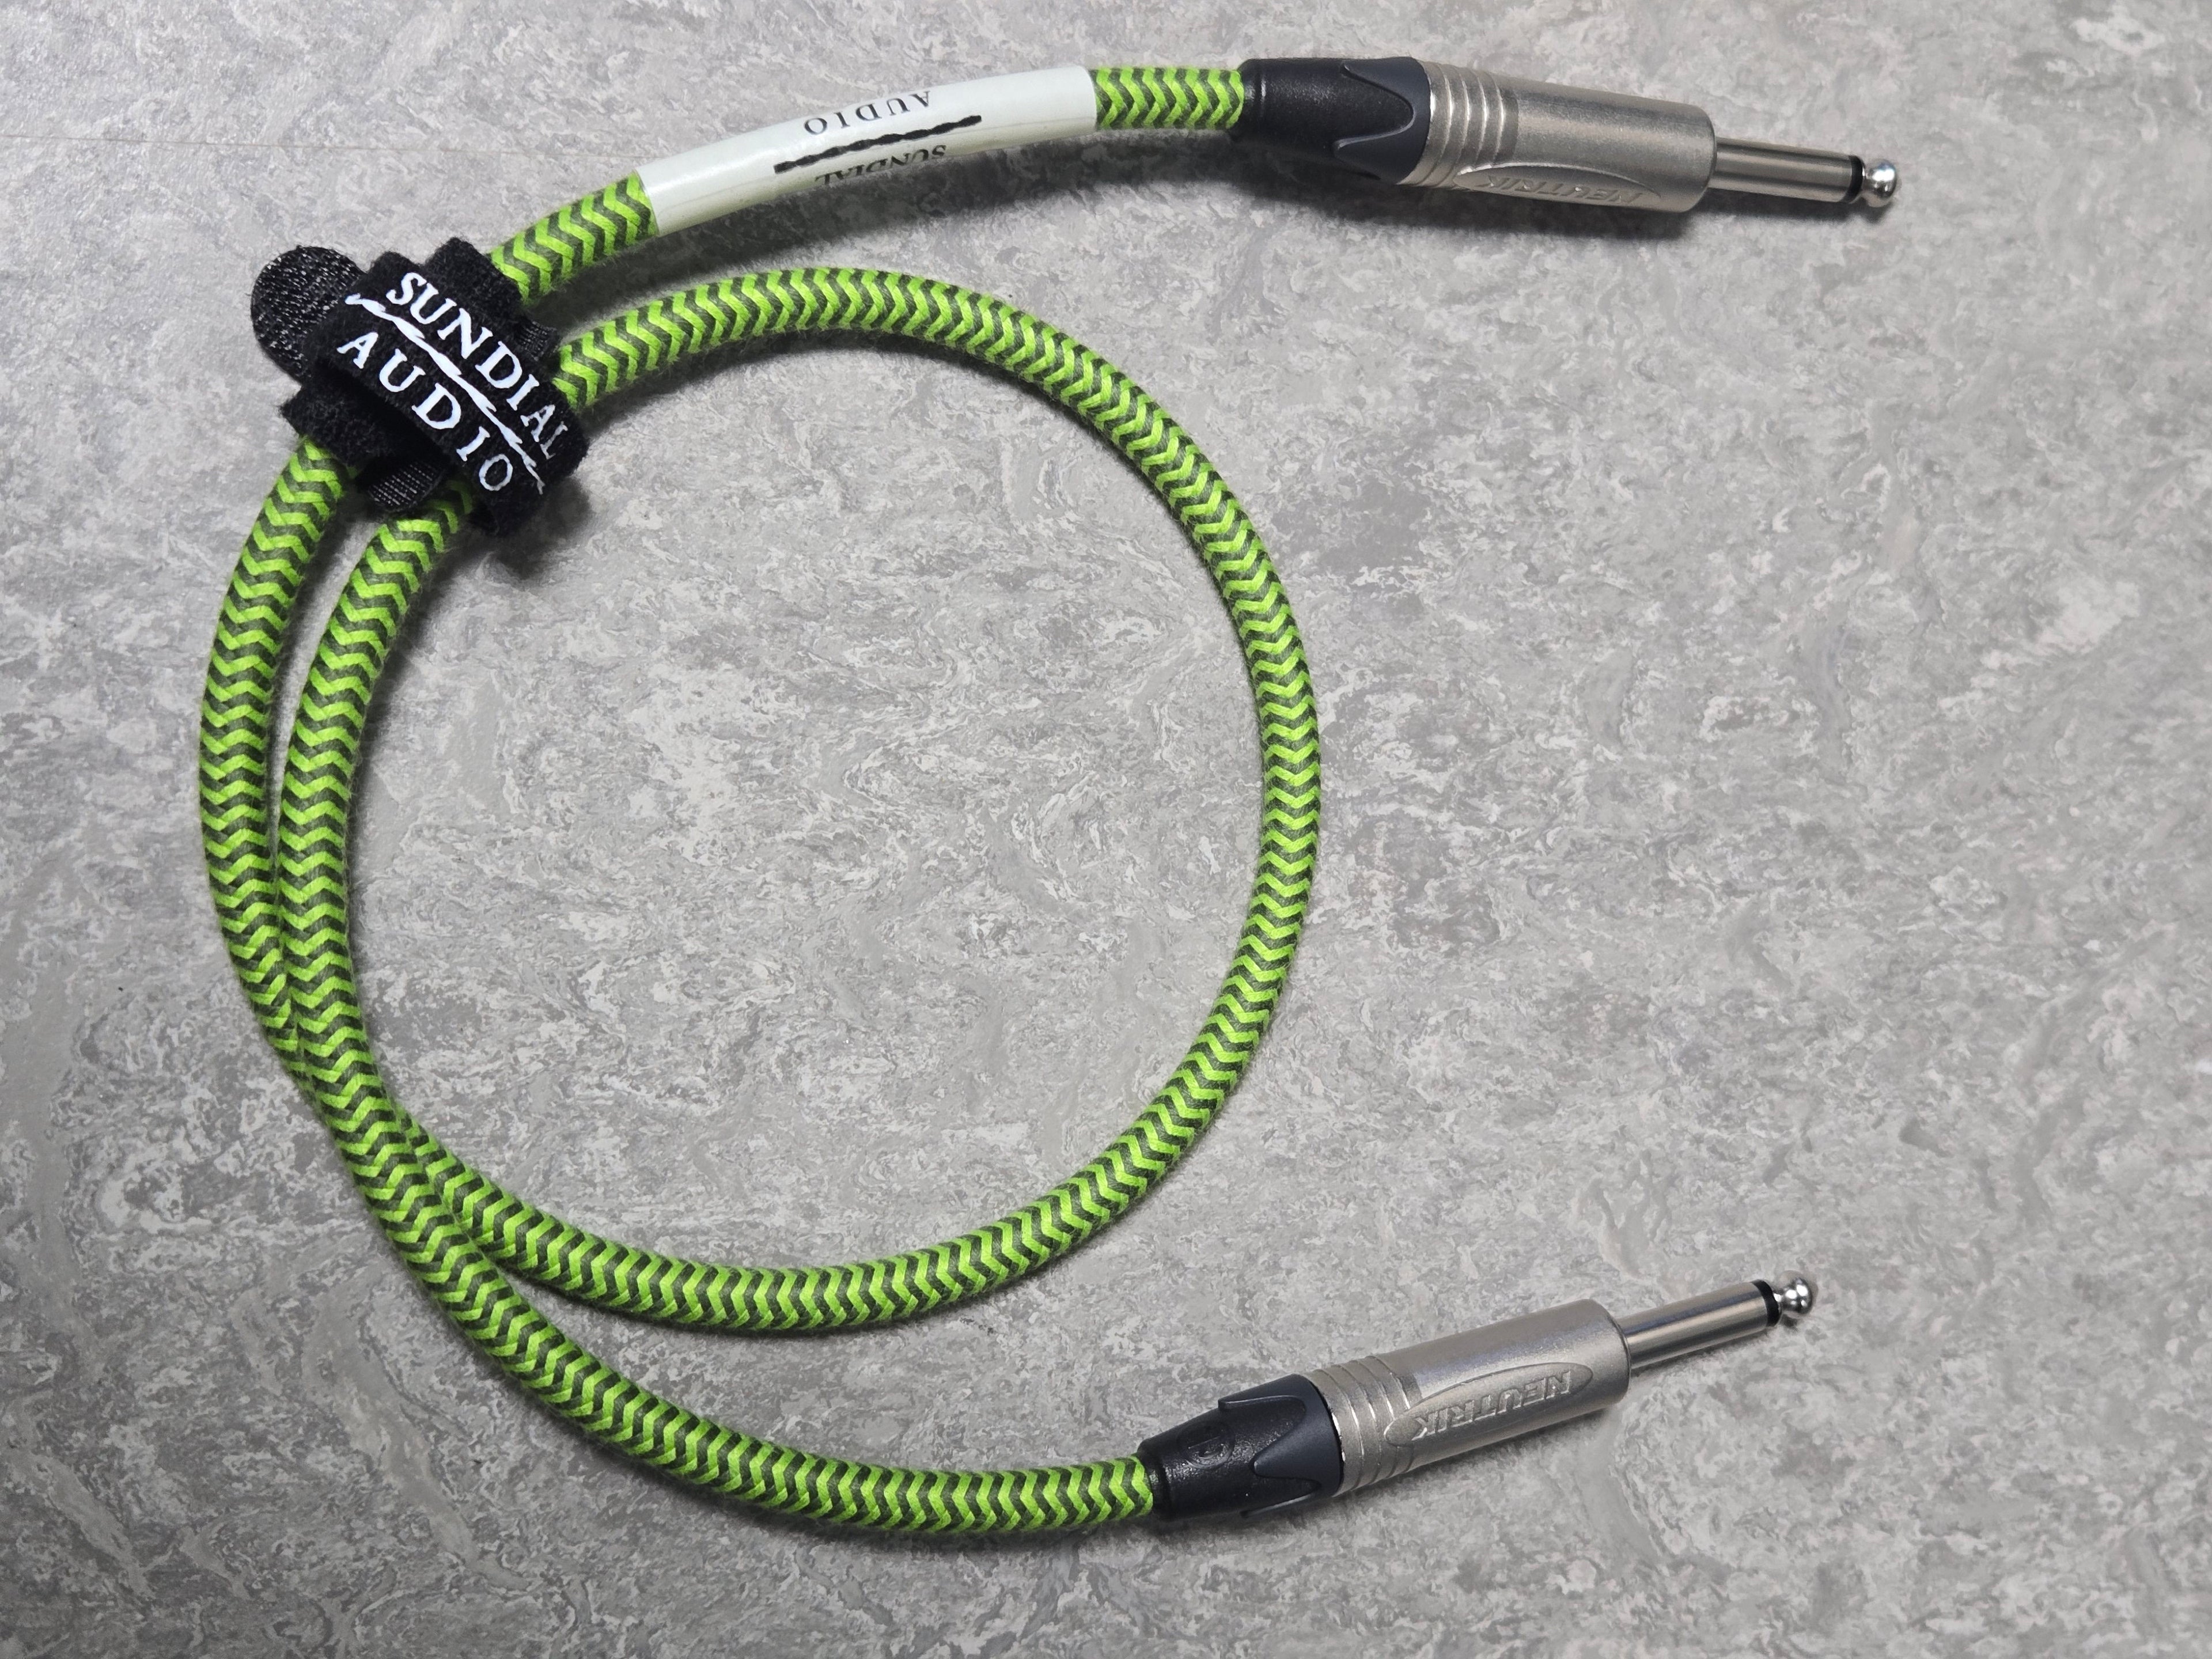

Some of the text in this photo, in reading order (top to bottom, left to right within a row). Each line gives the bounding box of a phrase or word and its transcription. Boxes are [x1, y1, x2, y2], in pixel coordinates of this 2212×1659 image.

[804, 90, 931, 135] AUDIO
[815, 145, 947, 185] SUNDIAL
[386, 272, 568, 460] SUNDIAL
[336, 331, 513, 491] AUDIO
[1411, 1368, 1572, 1441] NEUTRIK
